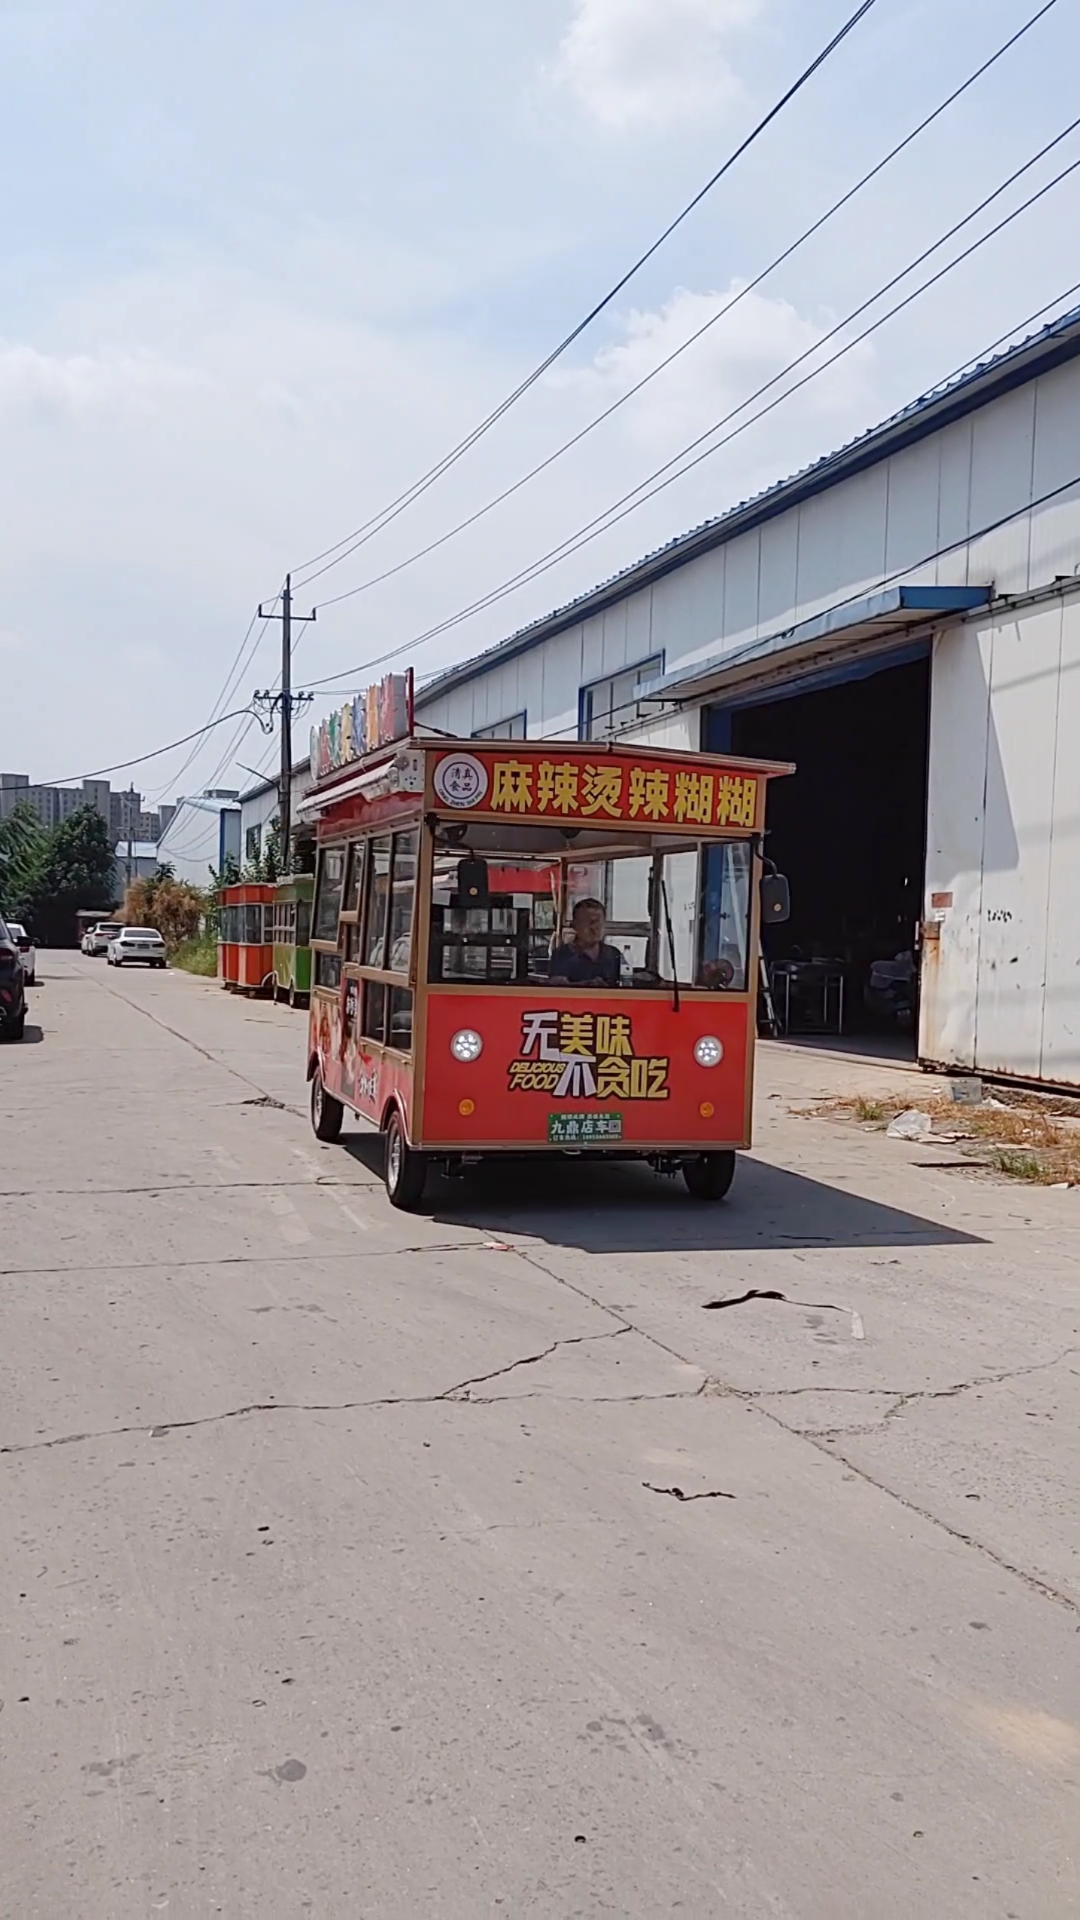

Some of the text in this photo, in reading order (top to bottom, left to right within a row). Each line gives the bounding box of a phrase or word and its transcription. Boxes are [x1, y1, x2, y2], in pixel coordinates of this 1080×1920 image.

[451, 767, 473, 780] 清真
[449, 780, 473, 792] 食品
[490, 759, 758, 828] 麻辣烫辣糊糊
[522, 1011, 633, 1061] 无美味
[509, 1062, 566, 1074] DELICIOUS
[552, 1052, 669, 1099] 不贪吃
[509, 1073, 560, 1090] FOOD
